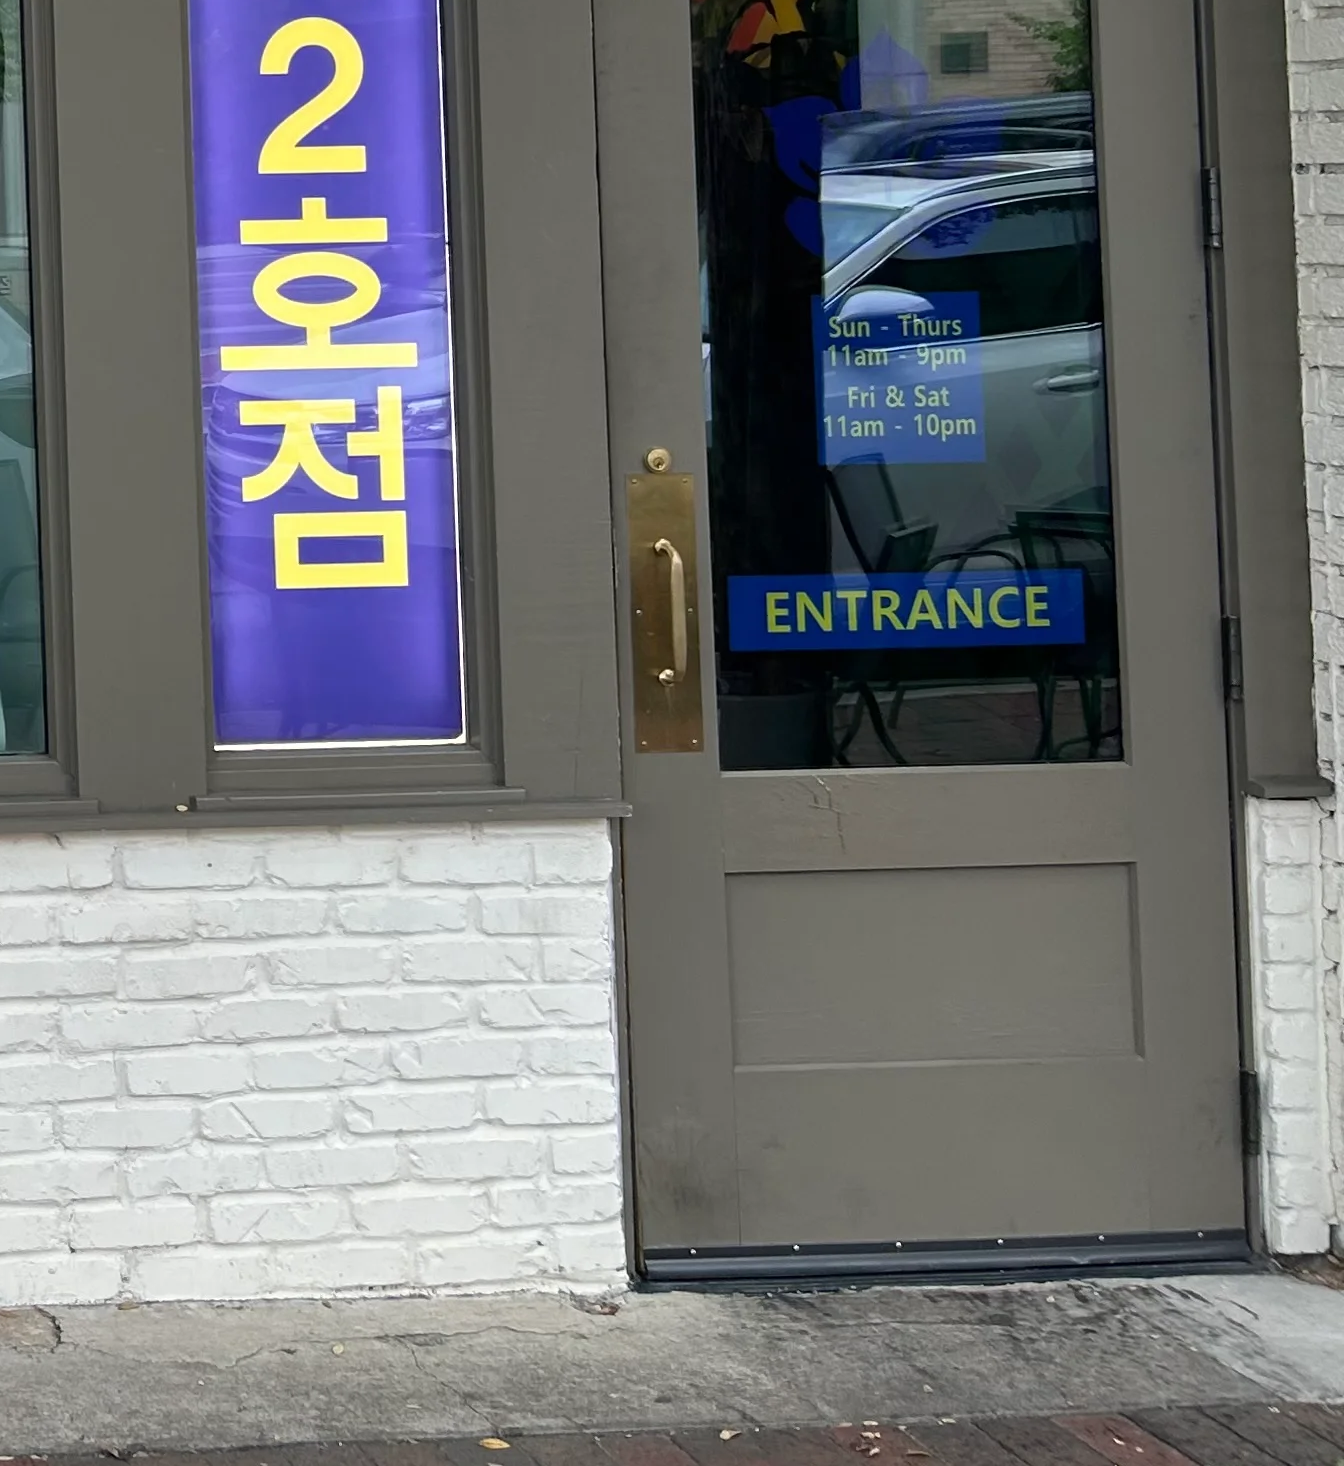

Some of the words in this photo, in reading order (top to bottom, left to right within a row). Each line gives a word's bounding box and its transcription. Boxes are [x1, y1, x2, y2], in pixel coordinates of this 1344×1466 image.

[828, 317, 871, 339] Sun
[897, 313, 963, 338] Thurs
[828, 345, 888, 368] 11am
[916, 344, 967, 372] 9pm
[847, 386, 876, 409] Fri
[885, 385, 906, 408] &
[913, 385, 950, 408] Sat
[824, 415, 885, 438] 11am
[913, 414, 977, 442] 10pm
[765, 585, 1051, 634] ENTRANCE
